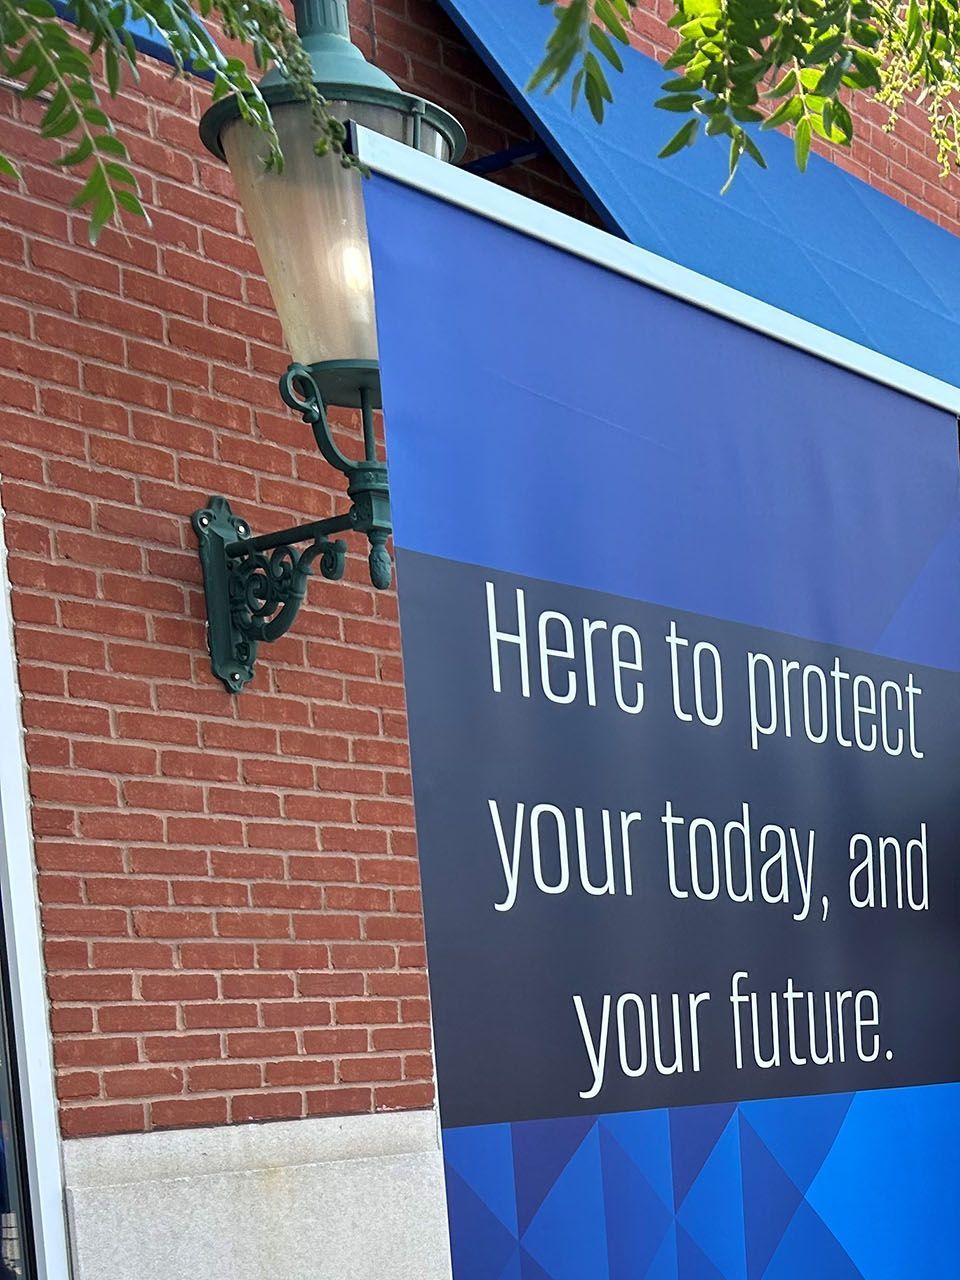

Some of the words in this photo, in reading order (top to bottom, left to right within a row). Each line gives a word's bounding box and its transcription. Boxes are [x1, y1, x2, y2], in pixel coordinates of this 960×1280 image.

[485, 581, 644, 714] Here
[665, 621, 725, 726] to
[747, 651, 924, 759] protect
[488, 799, 641, 911] your
[661, 801, 830, 922] today,
[849, 822, 929, 911] and
[573, 992, 710, 1099] your
[730, 971, 894, 1070] future.
